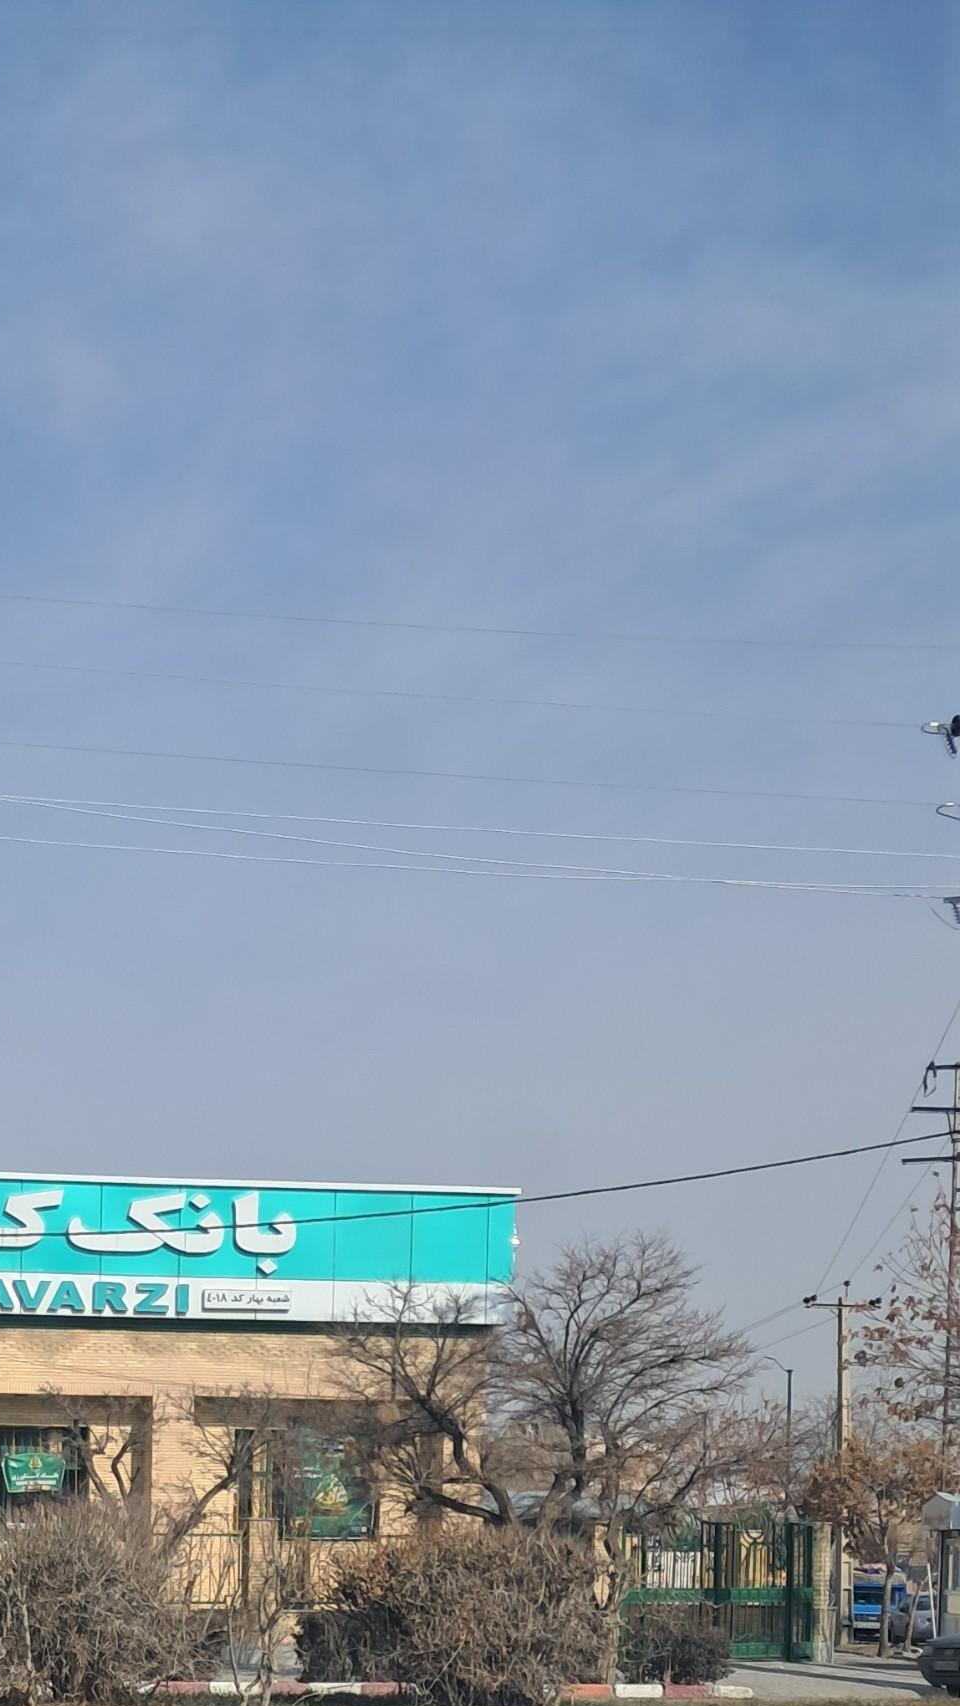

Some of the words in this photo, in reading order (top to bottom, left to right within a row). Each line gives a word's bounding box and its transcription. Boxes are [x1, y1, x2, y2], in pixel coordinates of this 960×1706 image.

[67, 1190, 297, 1276] بانک
[231, 1294, 244, 1303] کد
[266, 1294, 290, 1304] شعبه
